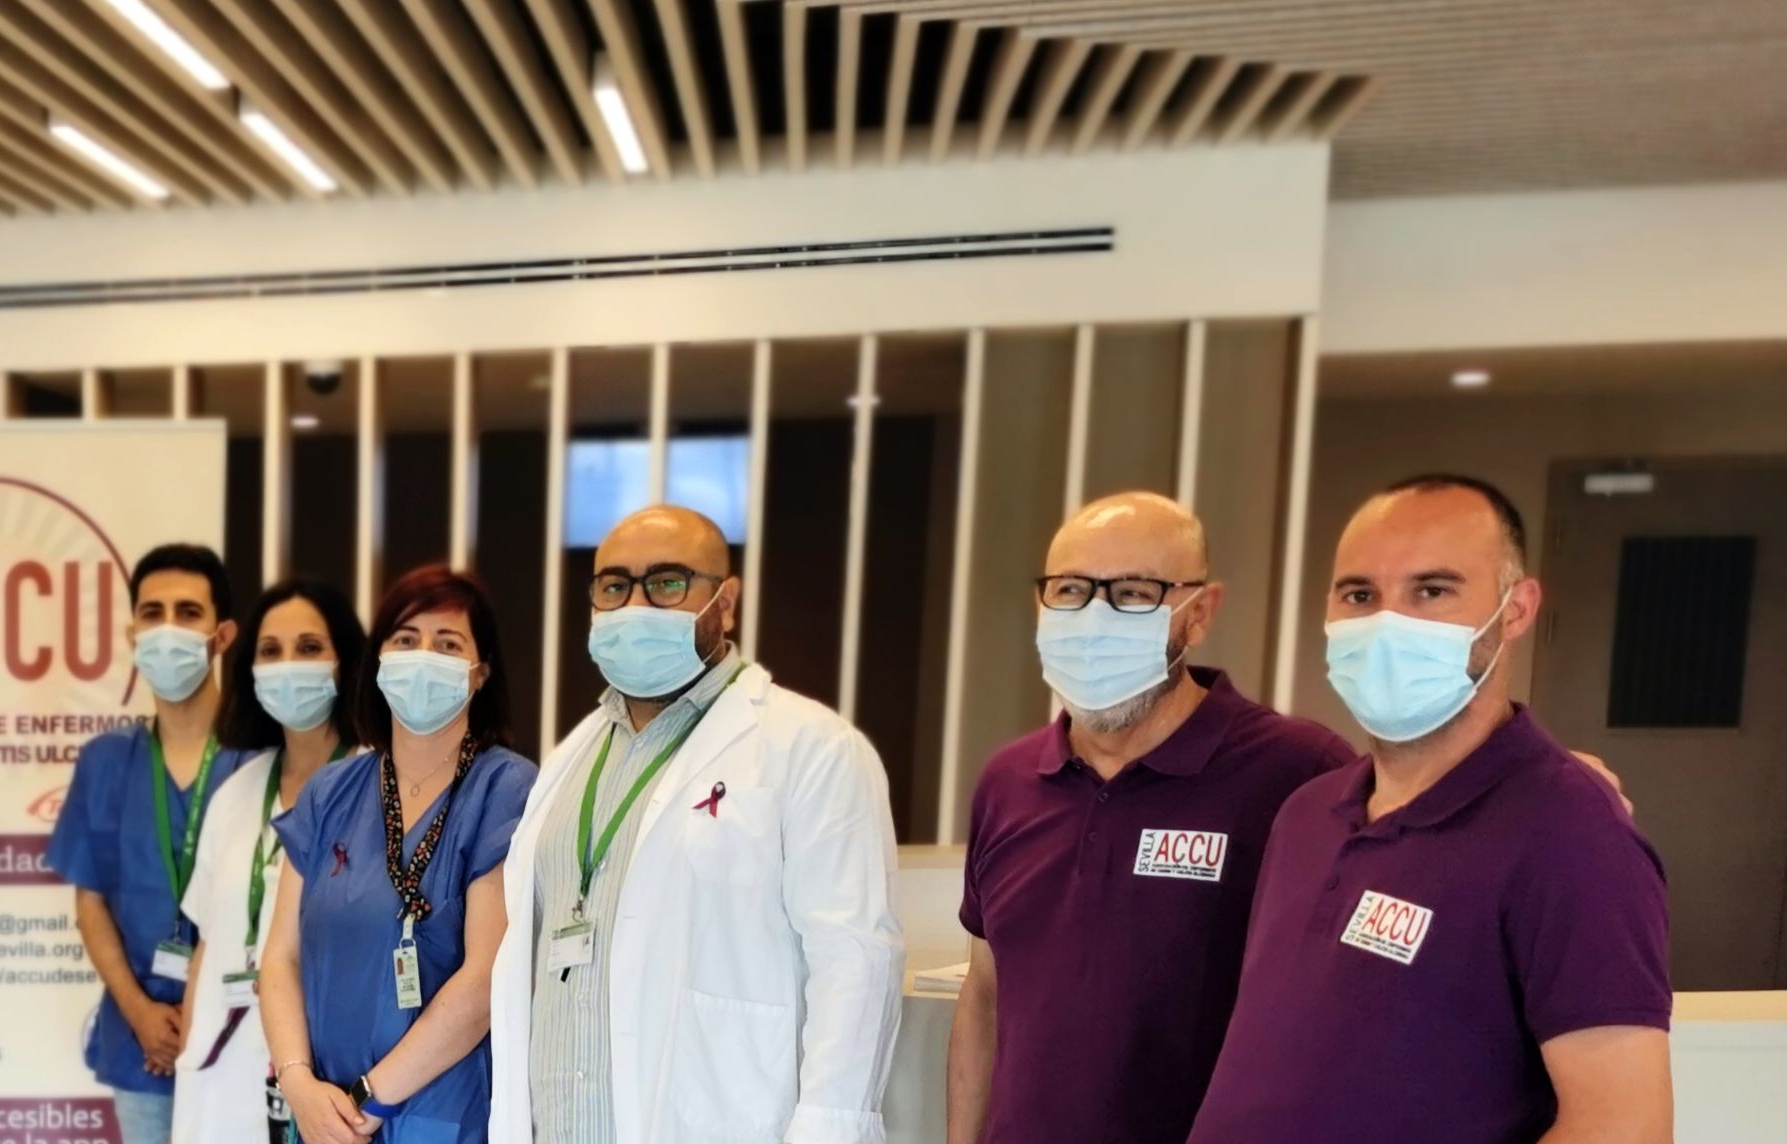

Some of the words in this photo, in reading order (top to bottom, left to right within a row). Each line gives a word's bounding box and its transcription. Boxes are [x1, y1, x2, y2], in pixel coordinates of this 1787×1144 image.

[35, 745, 81, 764] ULC
[1138, 831, 1156, 873] SEVILLA
[1153, 832, 1223, 867] ACCU
[1361, 898, 1427, 946] ACCU
